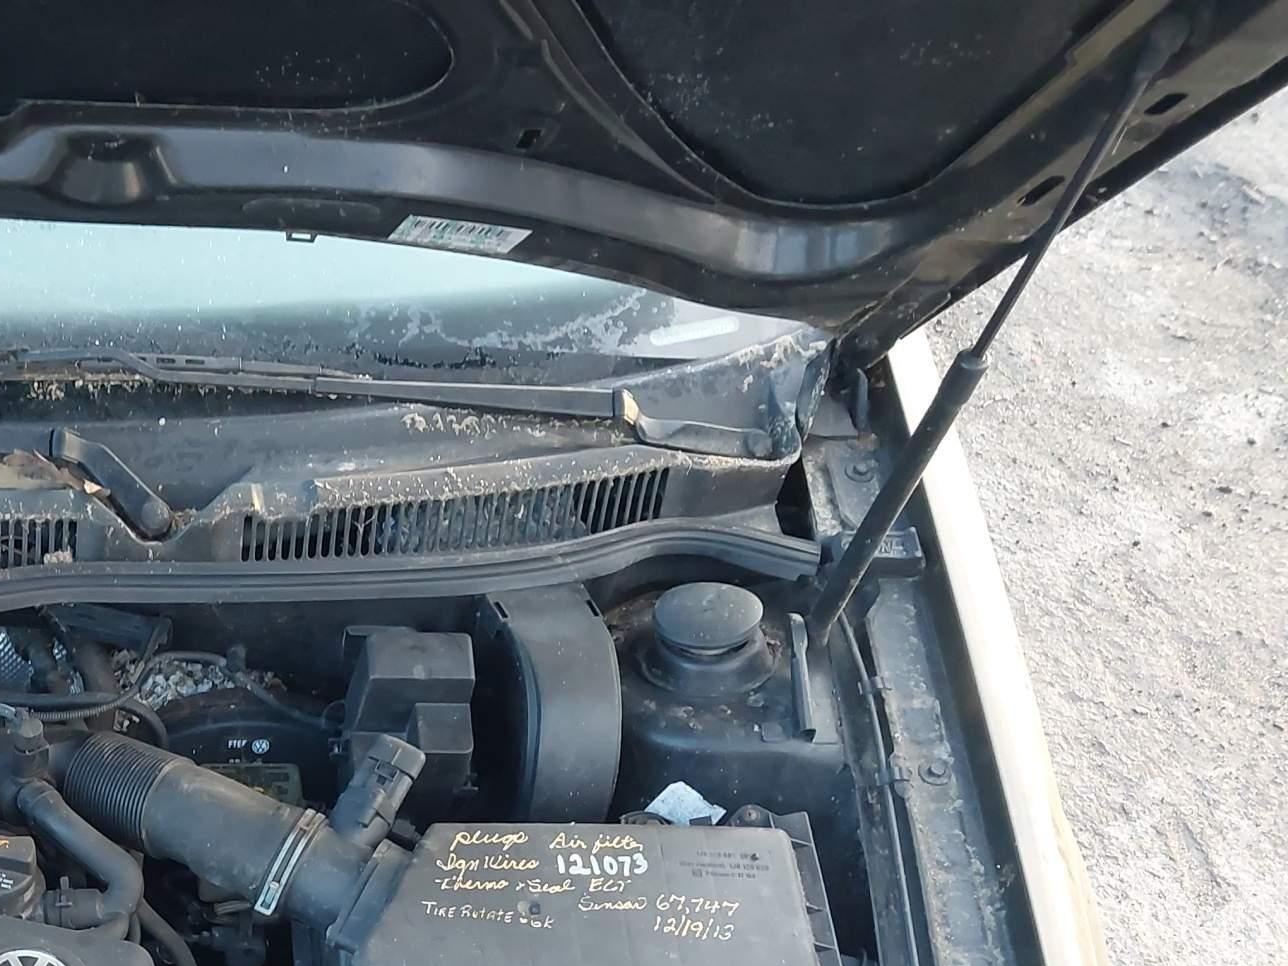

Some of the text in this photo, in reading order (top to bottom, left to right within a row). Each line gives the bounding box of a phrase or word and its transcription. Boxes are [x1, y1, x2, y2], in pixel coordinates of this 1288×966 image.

[548, 832, 588, 849] Air
[484, 854, 540, 870] Wires
[556, 852, 649, 876] 121073
[421, 901, 454, 918] TIRE
[655, 893, 741, 917] 67,747
[653, 914, 736, 941] 12/19/13
